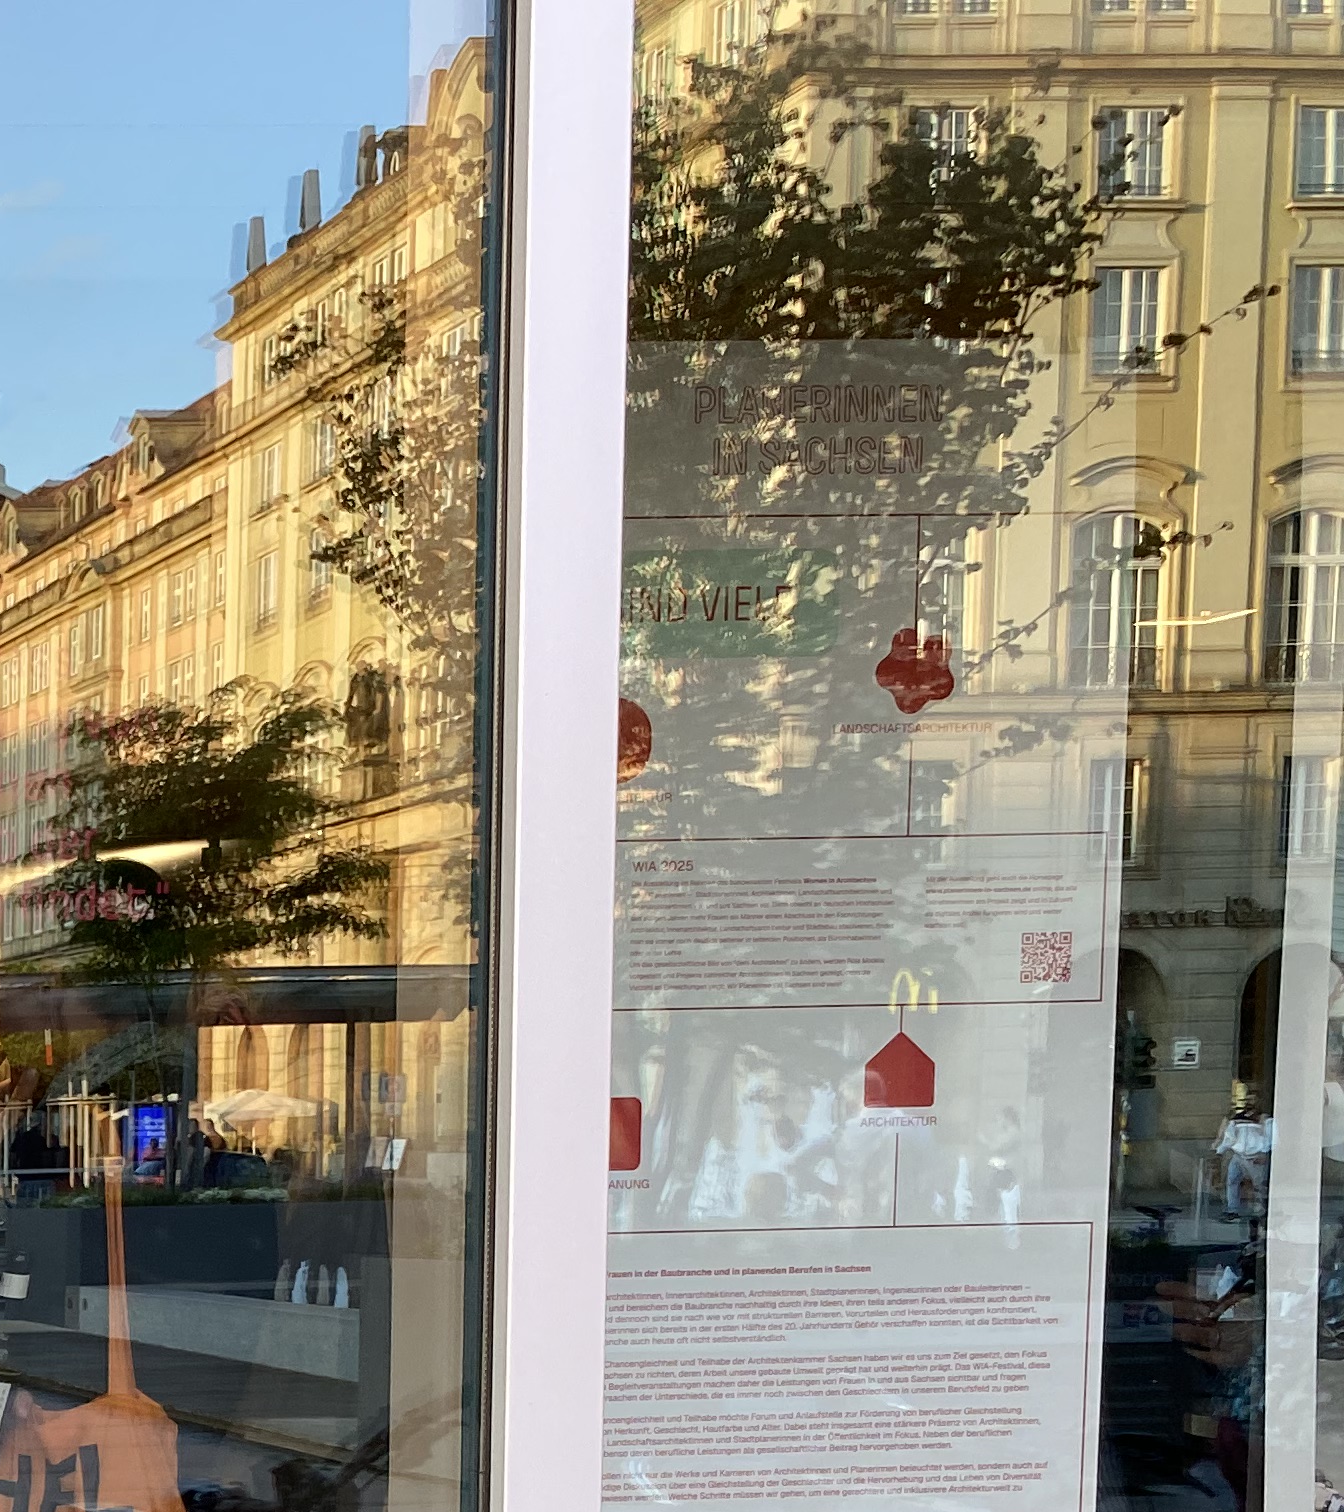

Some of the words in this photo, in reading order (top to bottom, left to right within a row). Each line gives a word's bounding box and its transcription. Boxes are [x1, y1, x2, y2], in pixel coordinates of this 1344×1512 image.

[693, 384, 944, 424] PLANERINNEN
[713, 437, 748, 476] IN
[758, 436, 924, 475] SACHSEN
[832, 722, 992, 735] LANDSCHAFTSARCHITEKTUR
[632, 861, 657, 872] WIA
[860, 1116, 938, 1128] ARCHITEKTUR
[661, 1268, 712, 1276] Baubranche
[742, 1267, 787, 1276] planenden
[789, 1266, 823, 1274] Berufen
[835, 1265, 871, 1273] Sachsen
